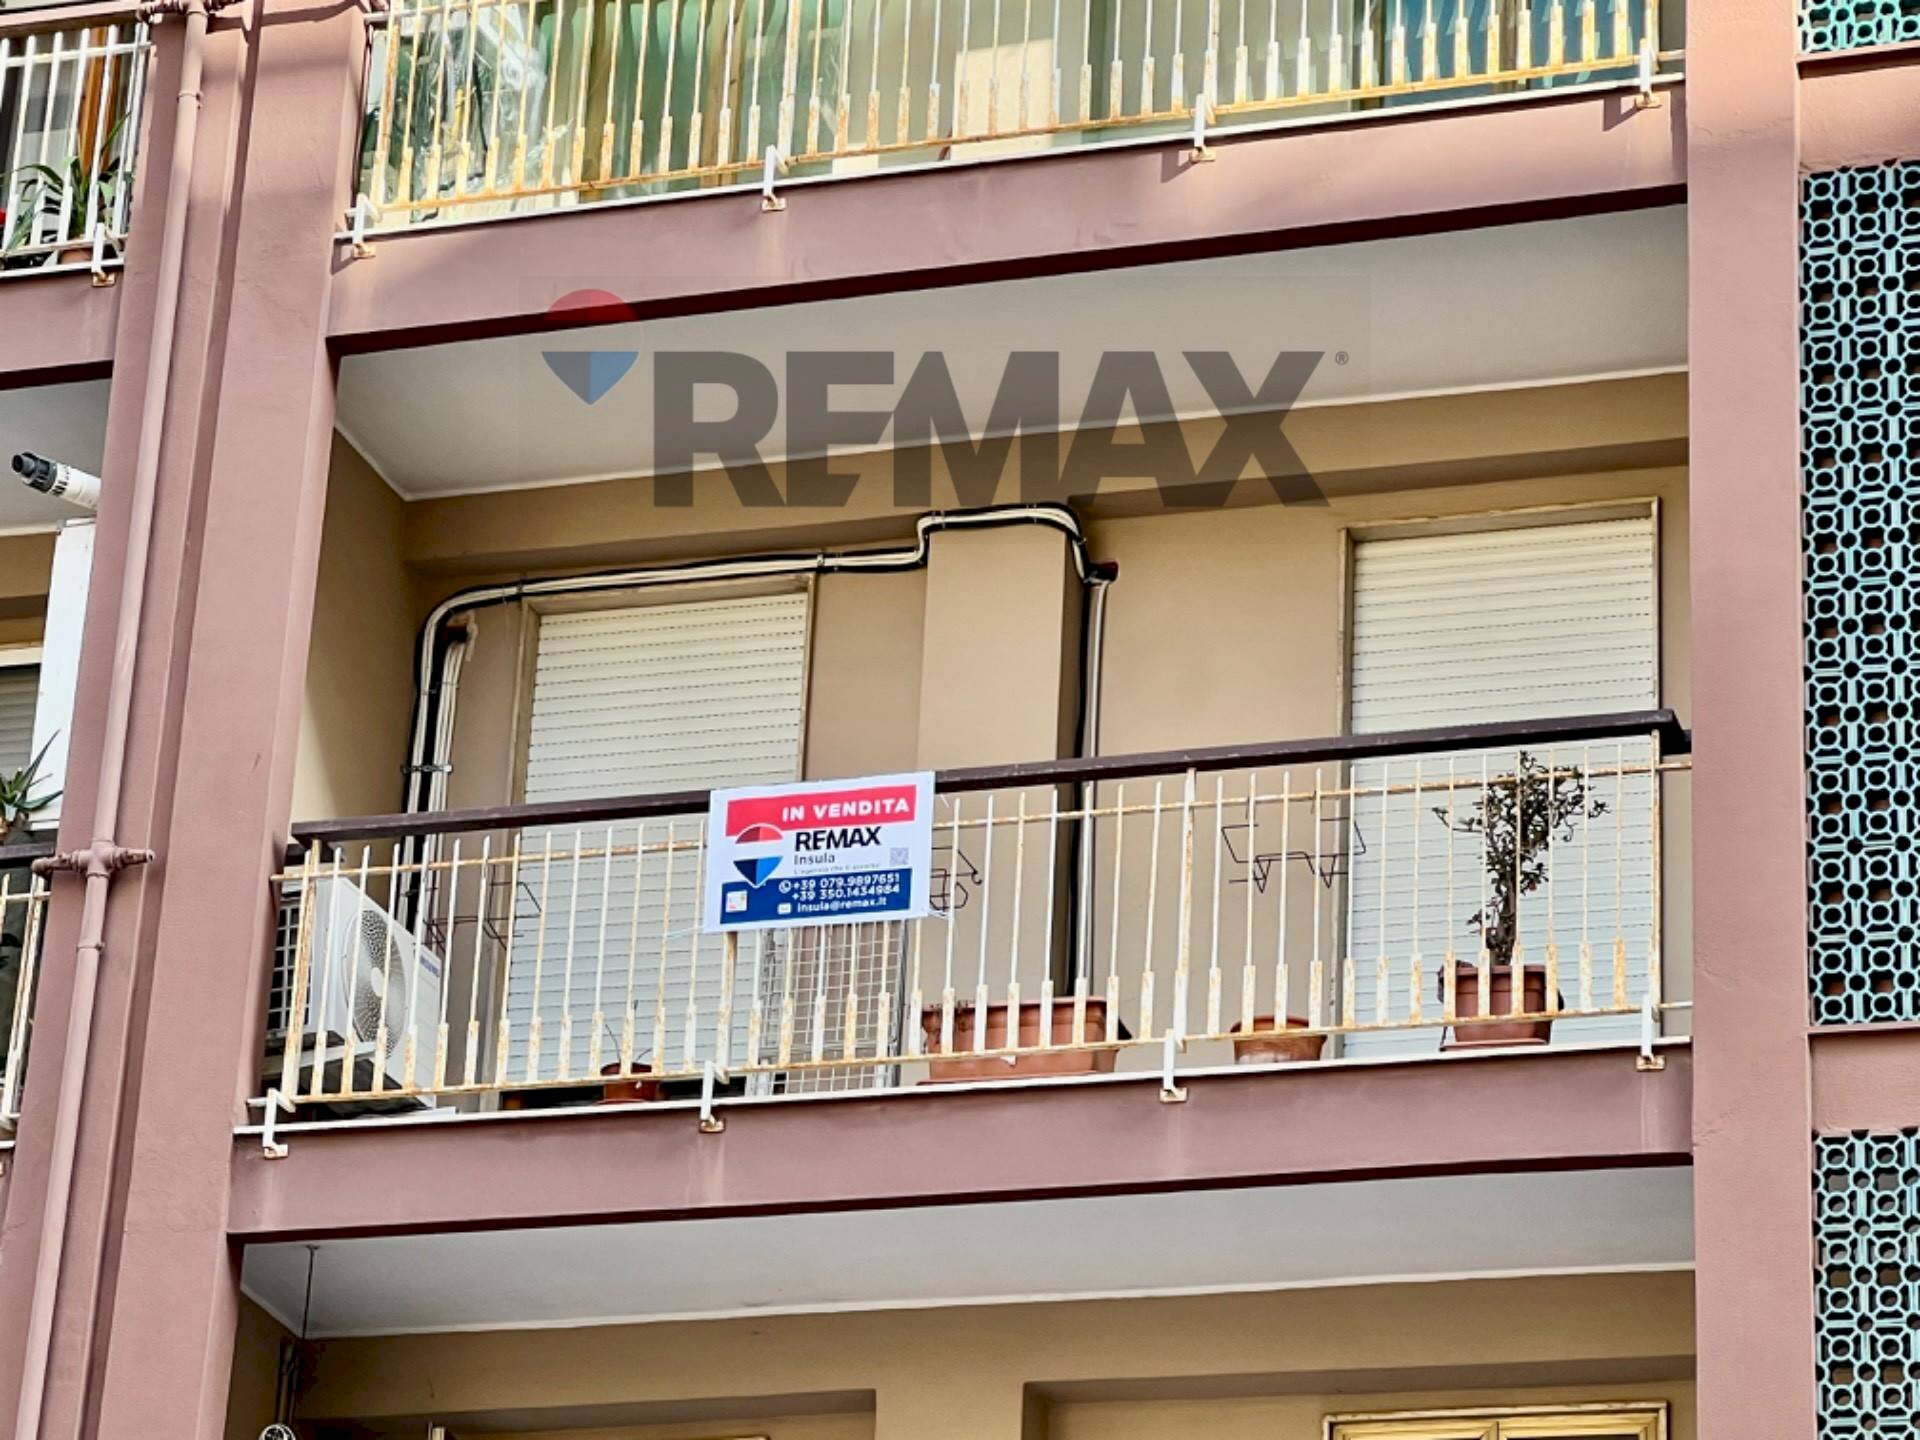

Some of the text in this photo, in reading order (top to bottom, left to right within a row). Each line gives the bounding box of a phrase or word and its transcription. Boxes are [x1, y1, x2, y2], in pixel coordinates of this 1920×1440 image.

[782, 797, 910, 822] IN VENDITA
[794, 826, 882, 852] REMAX
[793, 852, 836, 866] Insula
[793, 879, 816, 890] +39
[792, 890, 816, 902] +39
